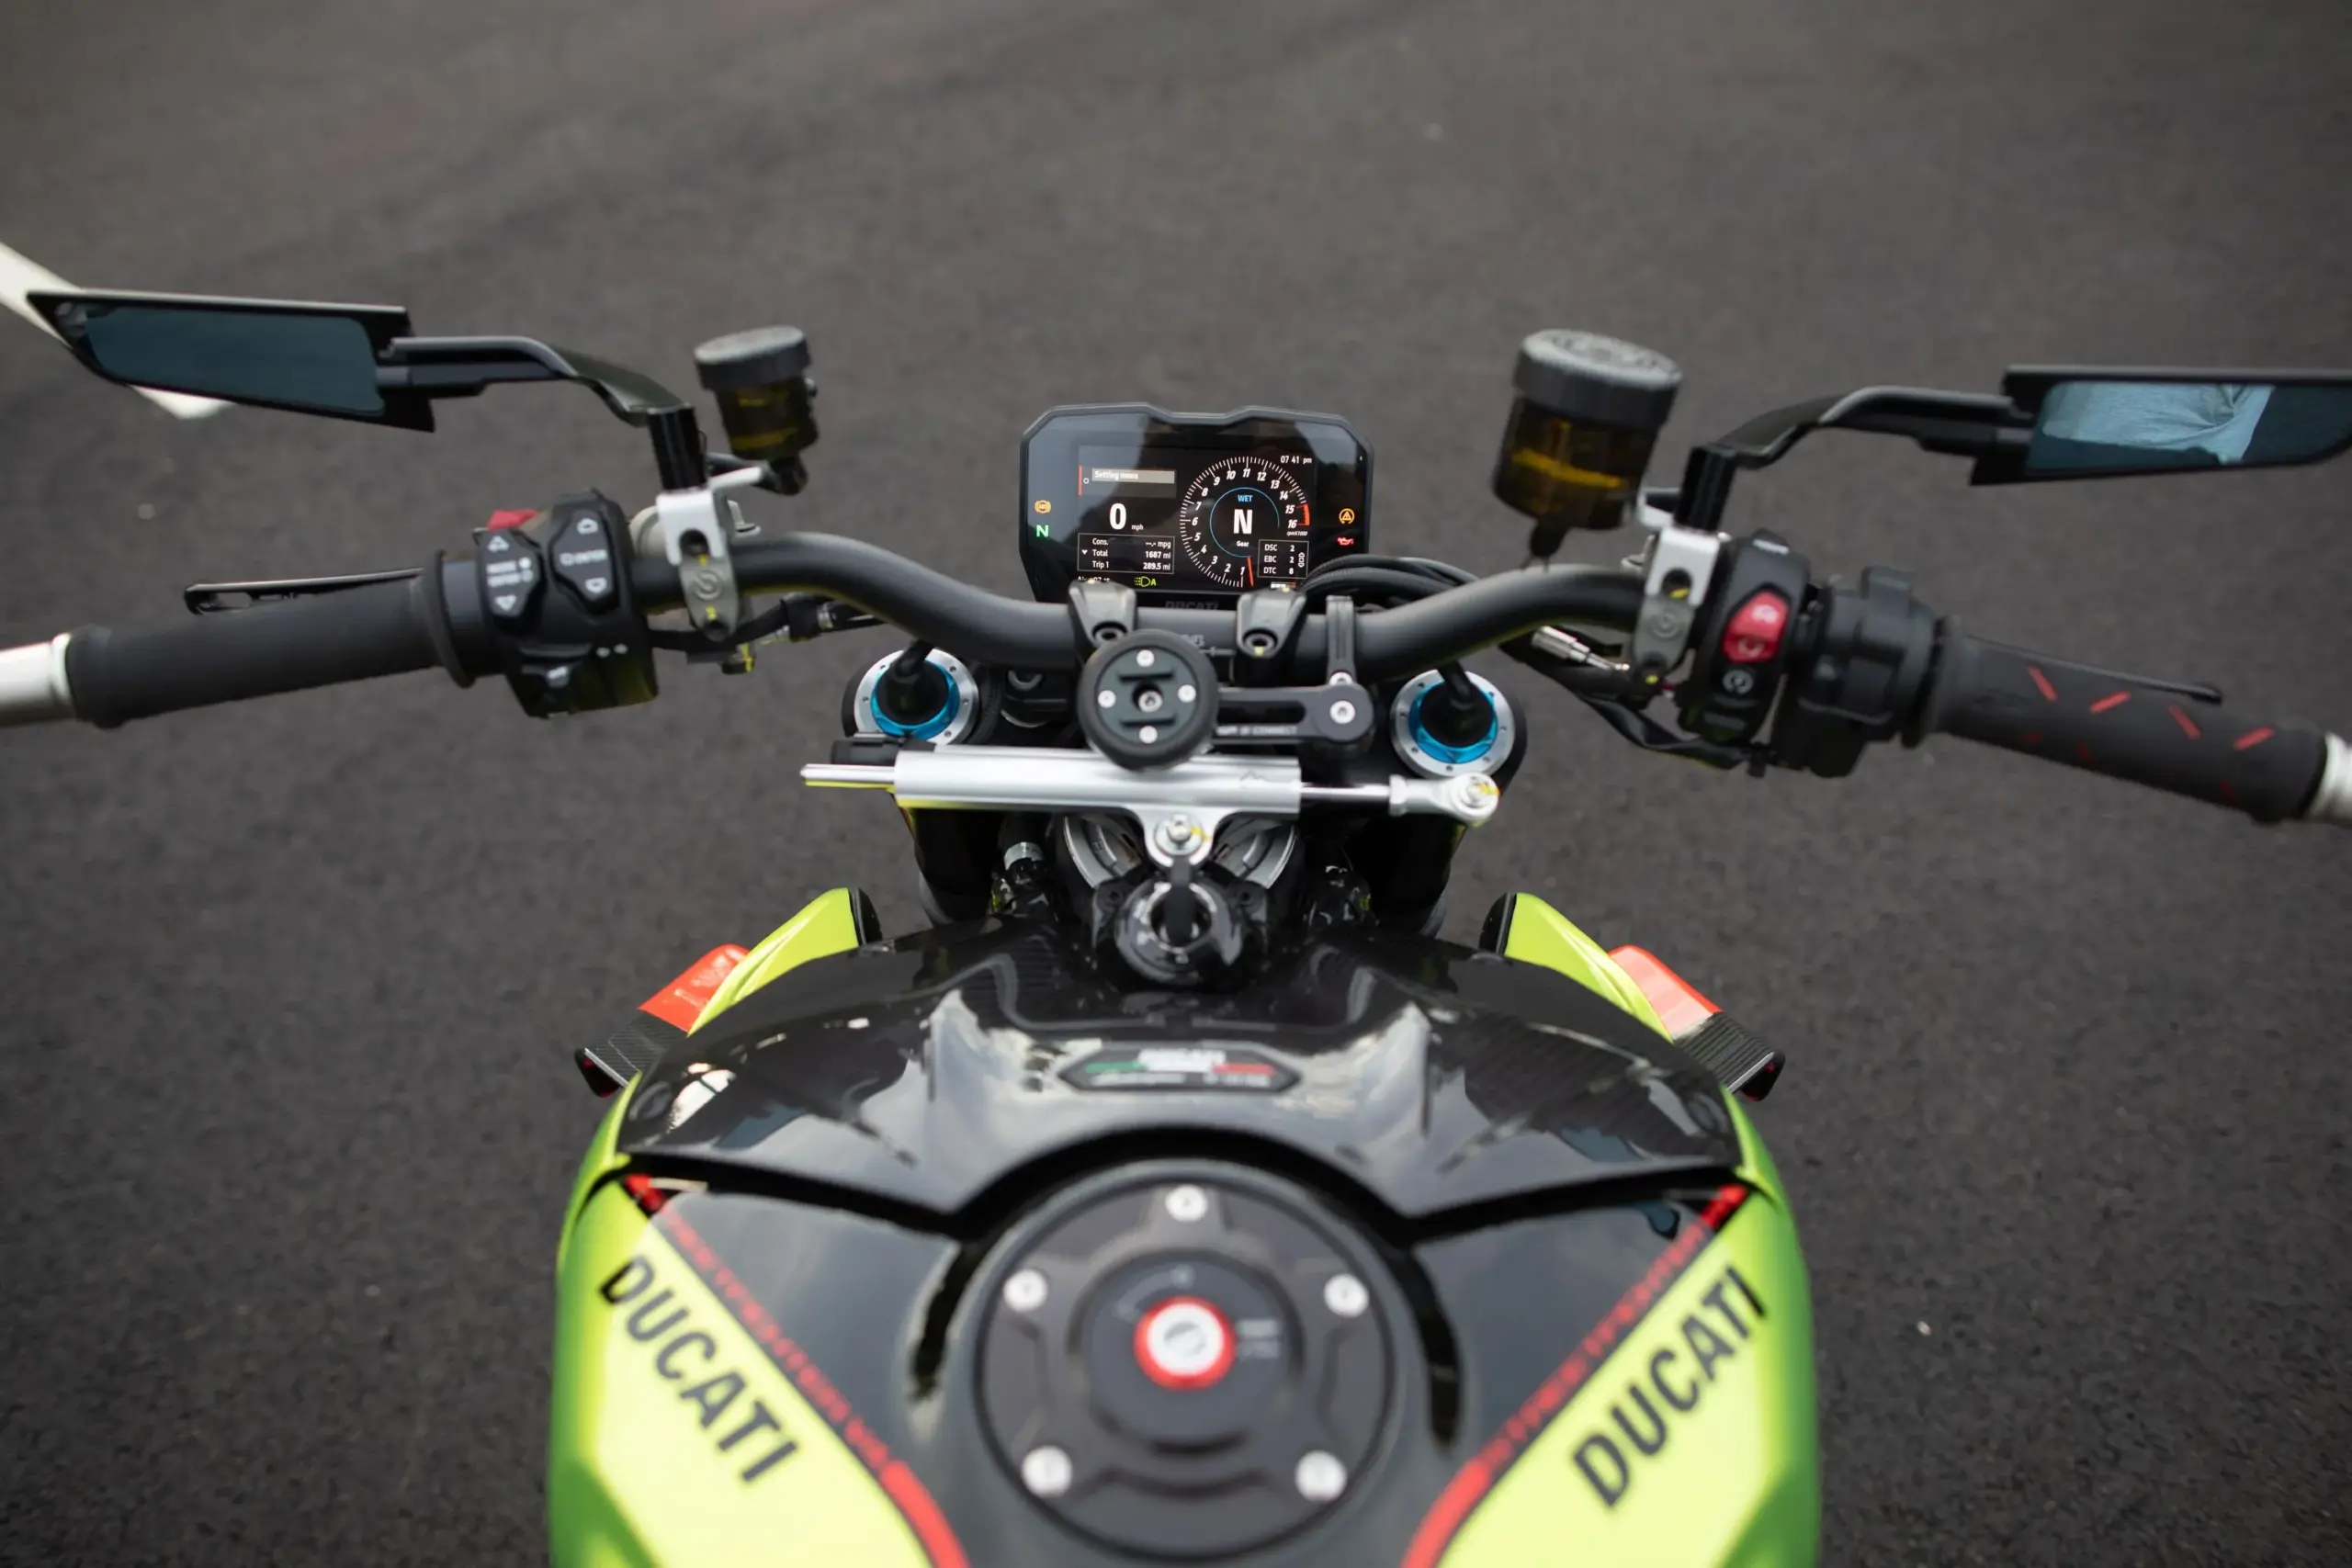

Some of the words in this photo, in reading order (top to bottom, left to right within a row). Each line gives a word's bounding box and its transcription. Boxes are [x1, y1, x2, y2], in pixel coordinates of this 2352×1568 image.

[1227, 470, 1236, 479] 10
[1242, 468, 1250, 478] 11
[1257, 472, 1267, 481] 12
[1214, 477, 1221, 486] 9
[1271, 479, 1280, 489] 13
[1201, 488, 1208, 497] 8
[1279, 491, 1288, 500] 14
[1195, 502, 1202, 511] 7
[1285, 505, 1295, 513] 15
[1109, 502, 1126, 530] 0
[1192, 517, 1198, 525] 6
[1233, 509, 1253, 534] N
[1287, 520, 1297, 528] 16
[1036, 525, 1049, 537] N
[1194, 533, 1201, 541] 5
[1158, 541, 1171, 549] mpg
[1201, 545, 1207, 553] 4
[1092, 560, 1104, 570] Trip
[1143, 562, 1161, 570] 289.5
[1212, 556, 1218, 565] 3
[1225, 563, 1231, 572] 2
[1240, 567, 1245, 575] 1
[599, 1255, 798, 1483] DUCATI
[1573, 1265, 1767, 1507] DUCATI
